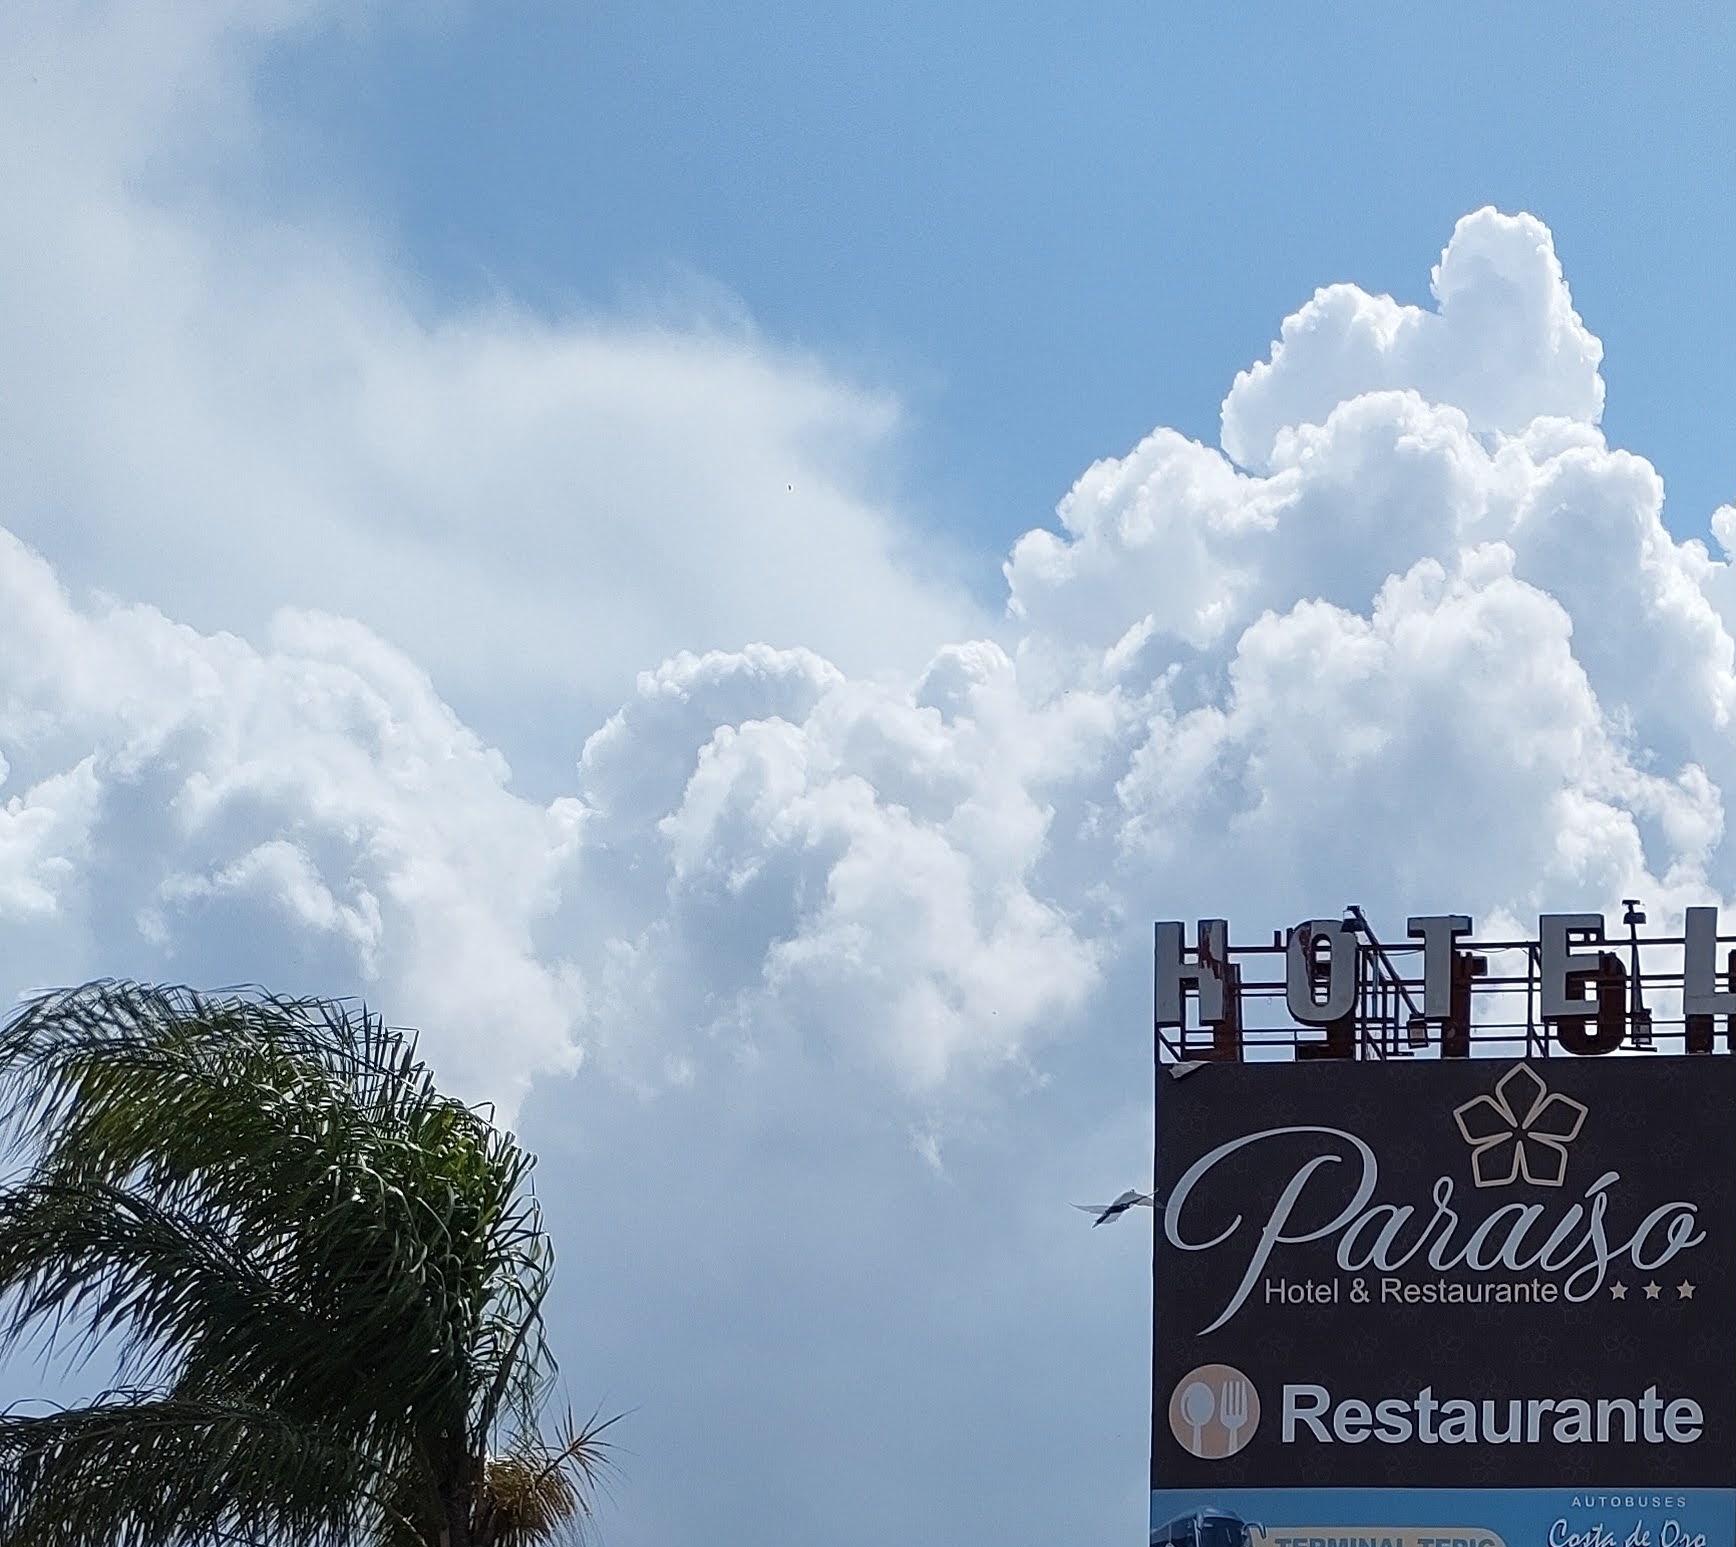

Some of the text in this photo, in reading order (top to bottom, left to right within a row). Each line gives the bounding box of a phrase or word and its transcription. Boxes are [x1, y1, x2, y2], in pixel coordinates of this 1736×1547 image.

[1163, 1125, 1707, 1336] Paraíso
[1264, 1277, 1559, 1304] Hotel & Restaurante
[1280, 1383, 1704, 1445] Restaurante
[1571, 1496, 1687, 1508] AUTOBUSES
